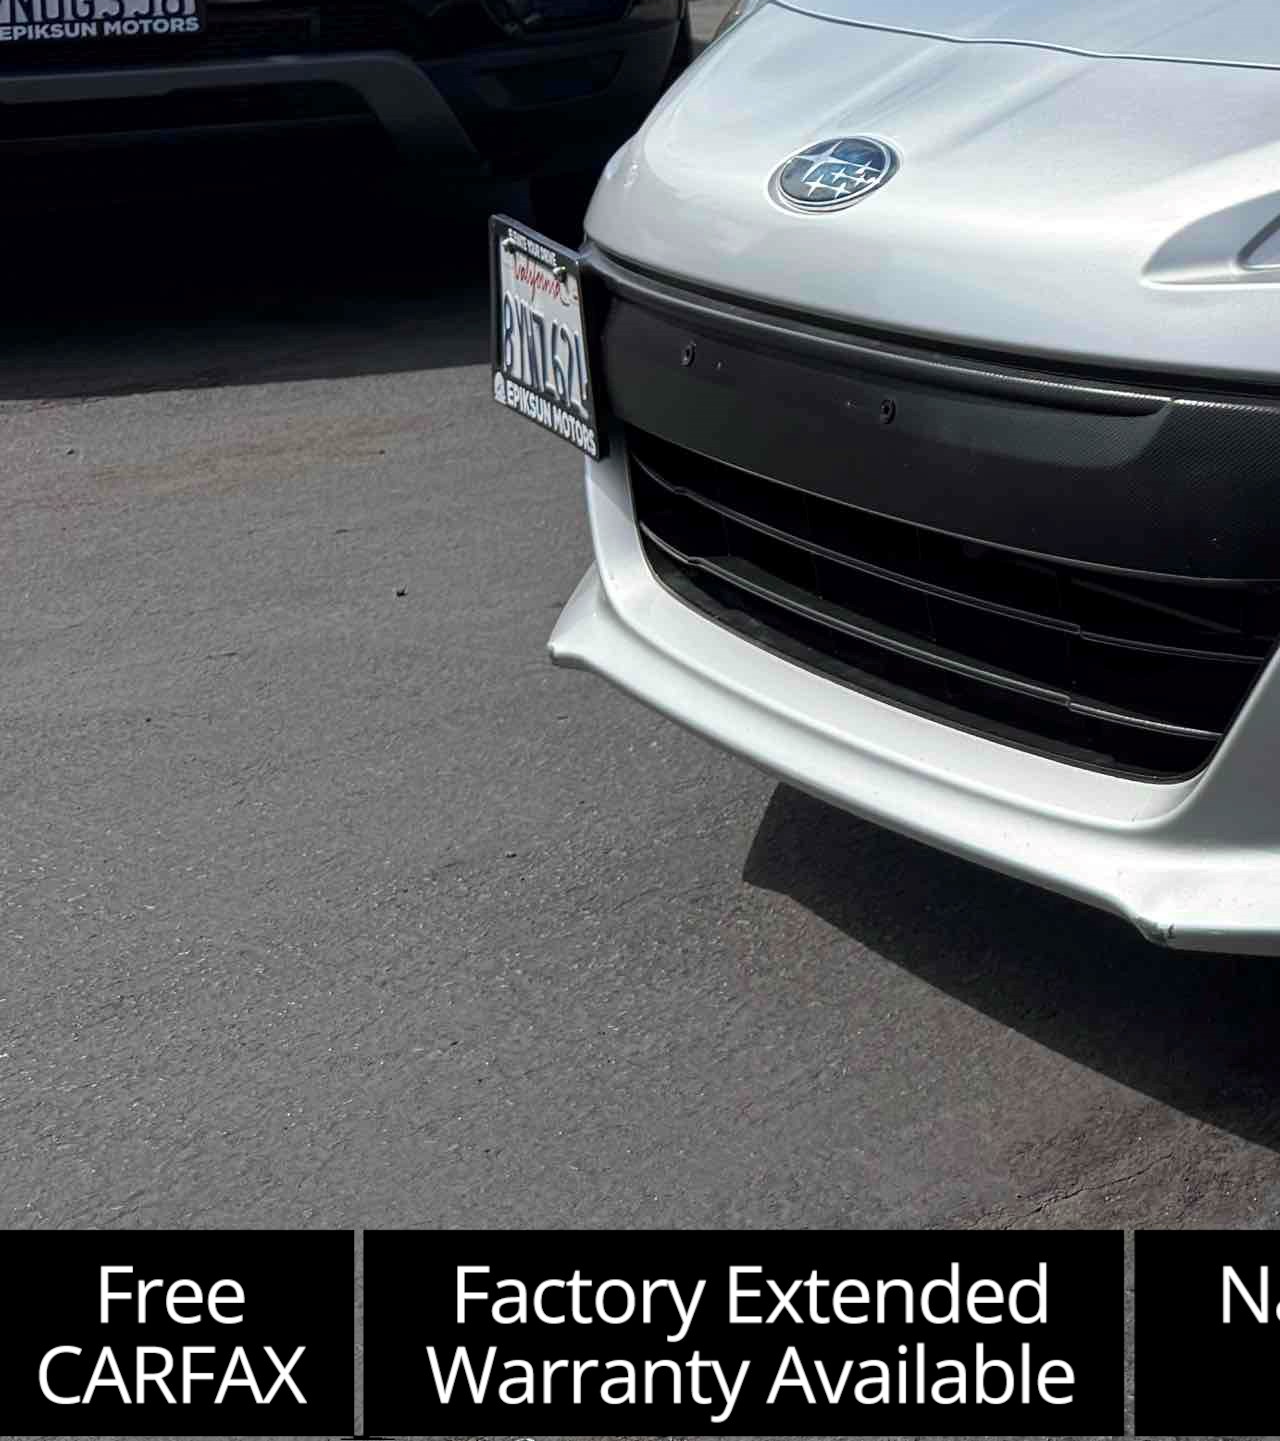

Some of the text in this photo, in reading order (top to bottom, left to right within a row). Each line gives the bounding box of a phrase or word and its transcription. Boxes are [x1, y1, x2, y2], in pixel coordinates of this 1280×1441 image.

[0, 16, 200, 41] EPIKSUN MOTORS
[505, 380, 597, 456] EPIKSUN MOTORS
